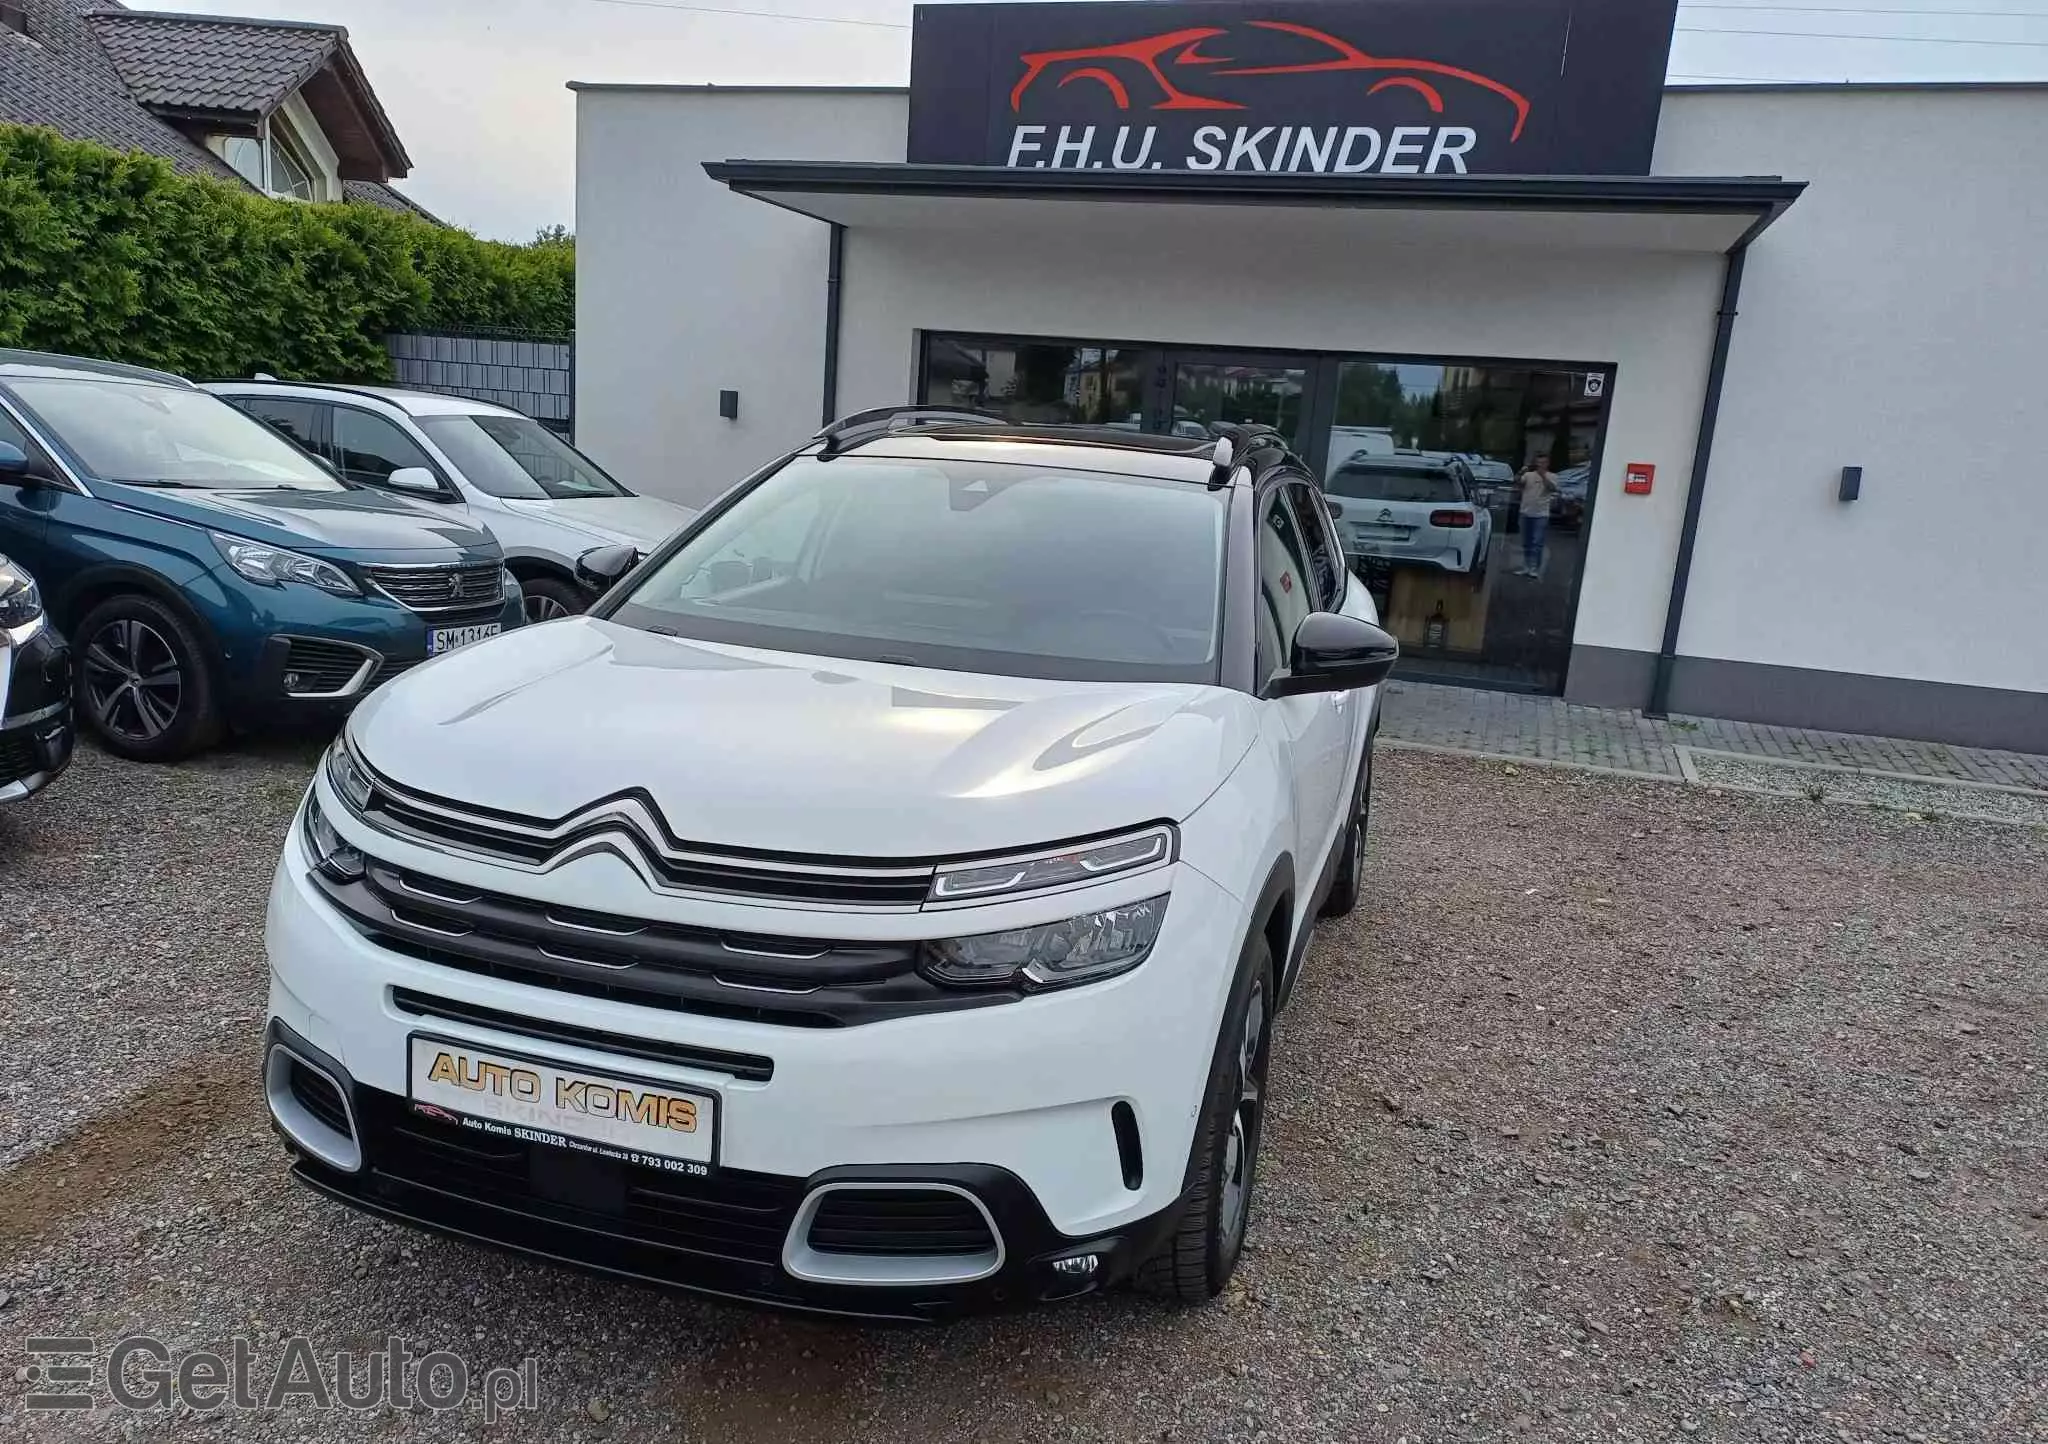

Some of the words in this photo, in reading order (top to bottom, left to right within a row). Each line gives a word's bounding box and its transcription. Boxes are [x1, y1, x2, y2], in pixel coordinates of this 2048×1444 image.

[1007, 125, 1162, 170] F.H.U.
[1186, 126, 1477, 174] SKINDER
[437, 630, 455, 650] SM
[428, 1052, 541, 1103] AUTO
[555, 1077, 697, 1133] KOMIS
[462, 1116, 483, 1130] Auto
[484, 1121, 512, 1136] Komis
[514, 1127, 567, 1148] SKINDER
[642, 1155, 661, 1168] 793
[664, 1159, 684, 1172] 002
[687, 1164, 708, 1176] 309
